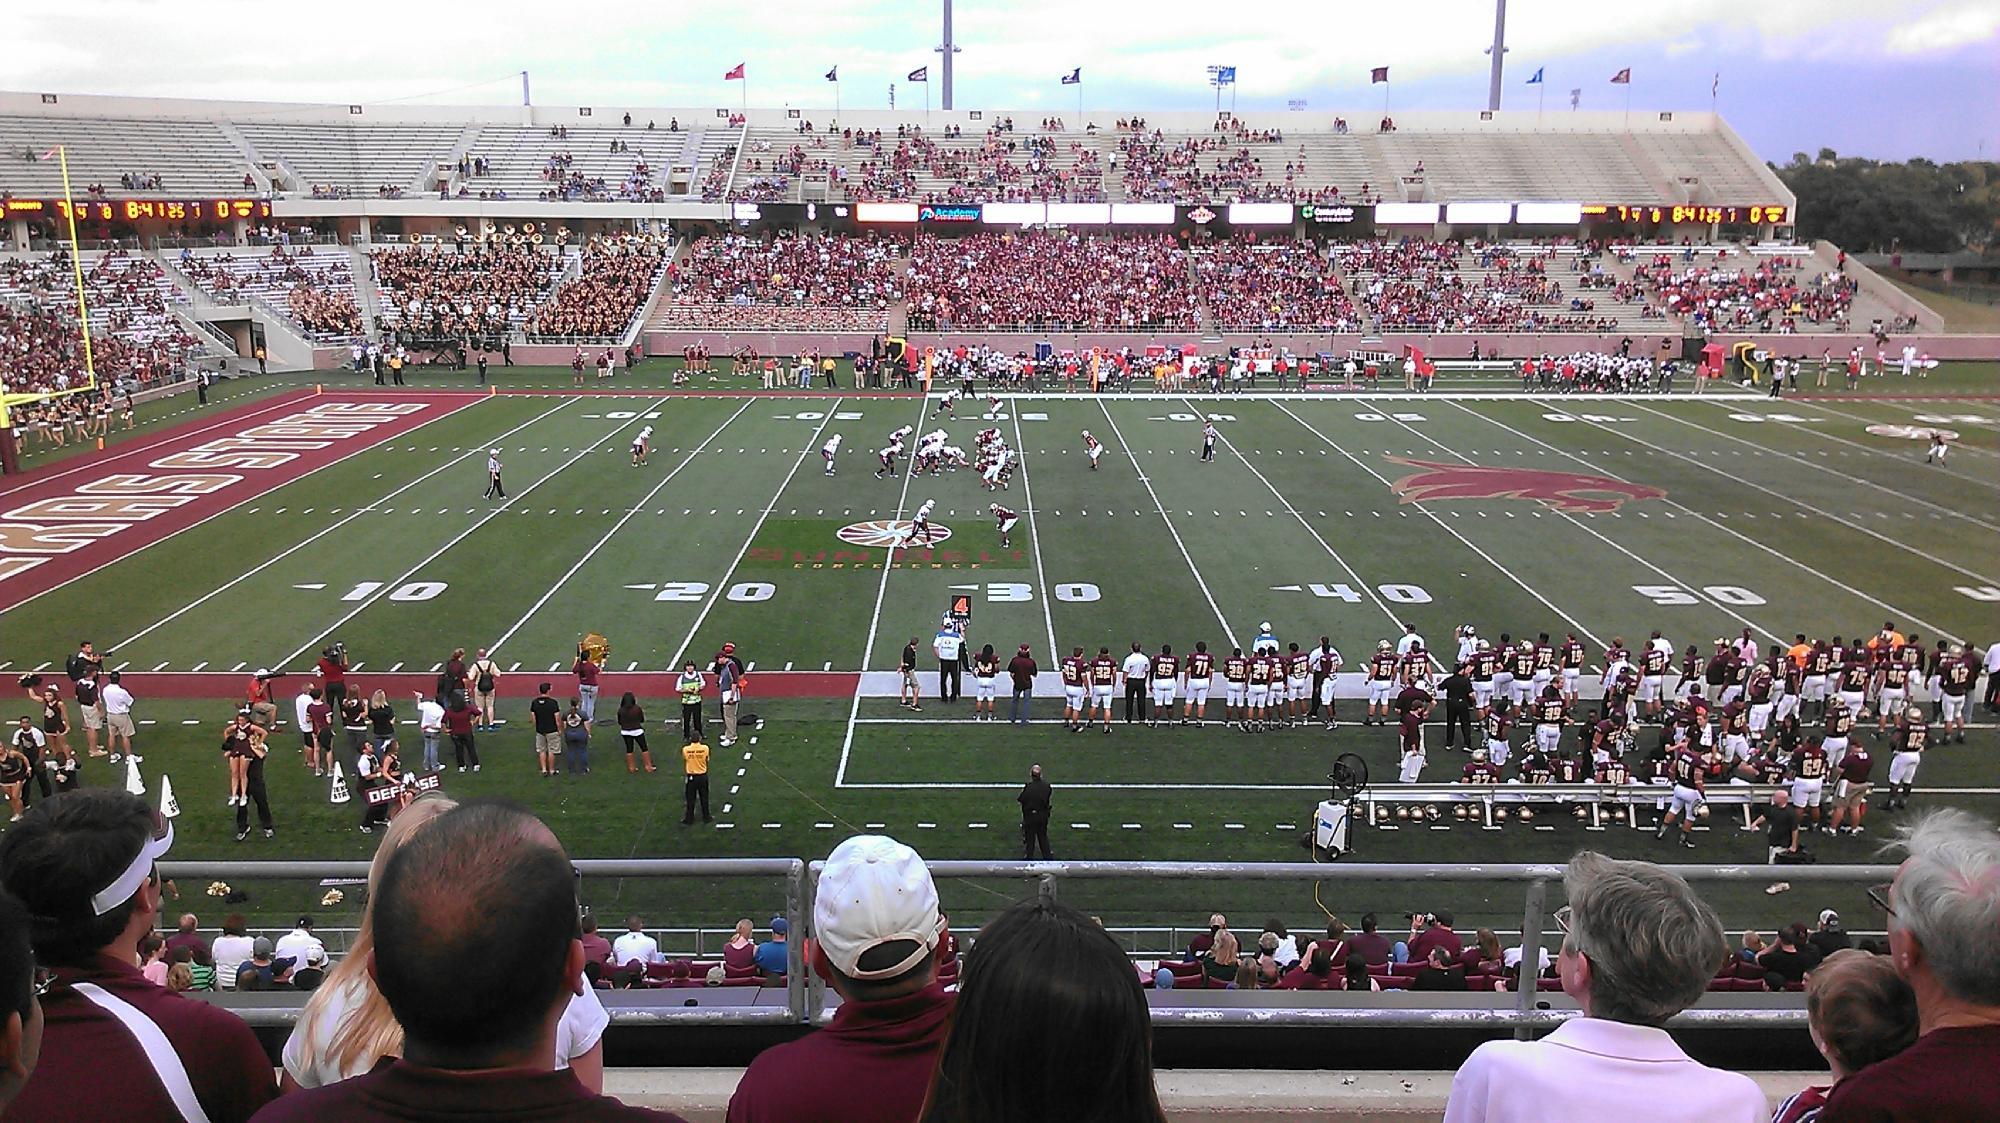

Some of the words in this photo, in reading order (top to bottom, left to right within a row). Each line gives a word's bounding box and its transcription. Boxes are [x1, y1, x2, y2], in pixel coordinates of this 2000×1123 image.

[935, 207, 979, 219] Academy
[148, 403, 432, 469] STATE
[341, 582, 448, 600] 10
[654, 582, 776, 600] 20
[987, 583, 1101, 602] 30
[1311, 583, 1433, 603] 40
[1631, 585, 1767, 605] 50
[954, 597, 968, 613] 4
[1095, 667, 1110, 679] 32
[1157, 664, 1174, 676] 93
[1195, 661, 1208, 675] 71
[1379, 664, 1391, 676] 51
[1481, 662, 1493, 675] 91
[1518, 661, 1533, 675] 97
[1850, 671, 1866, 685] 75
[1803, 759, 1821, 776] 69
